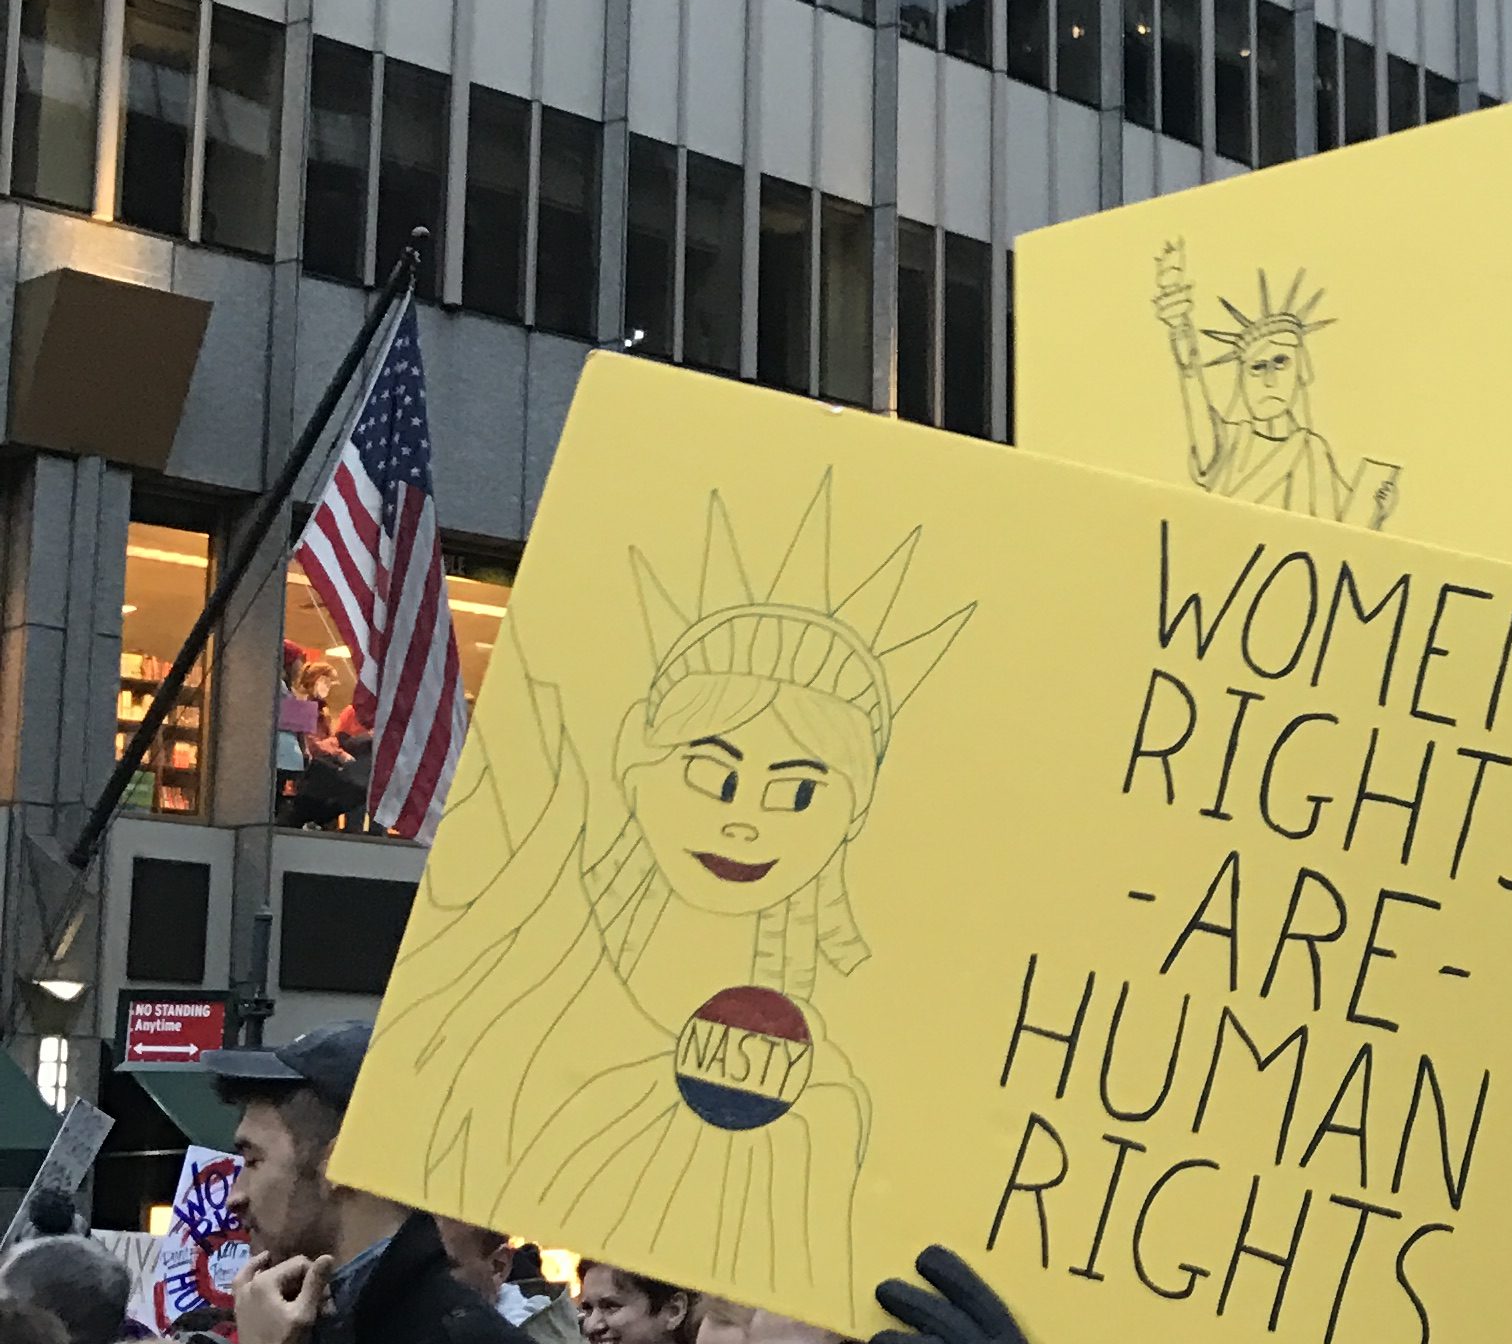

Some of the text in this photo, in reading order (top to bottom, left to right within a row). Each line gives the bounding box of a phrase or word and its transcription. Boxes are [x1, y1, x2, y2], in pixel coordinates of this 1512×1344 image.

[134, 1018, 182, 1034] Anytime
[135, 1003, 211, 1018] NO STANDING
[681, 1021, 810, 1099] NASTY
[1000, 952, 1490, 1211] HUMAN
